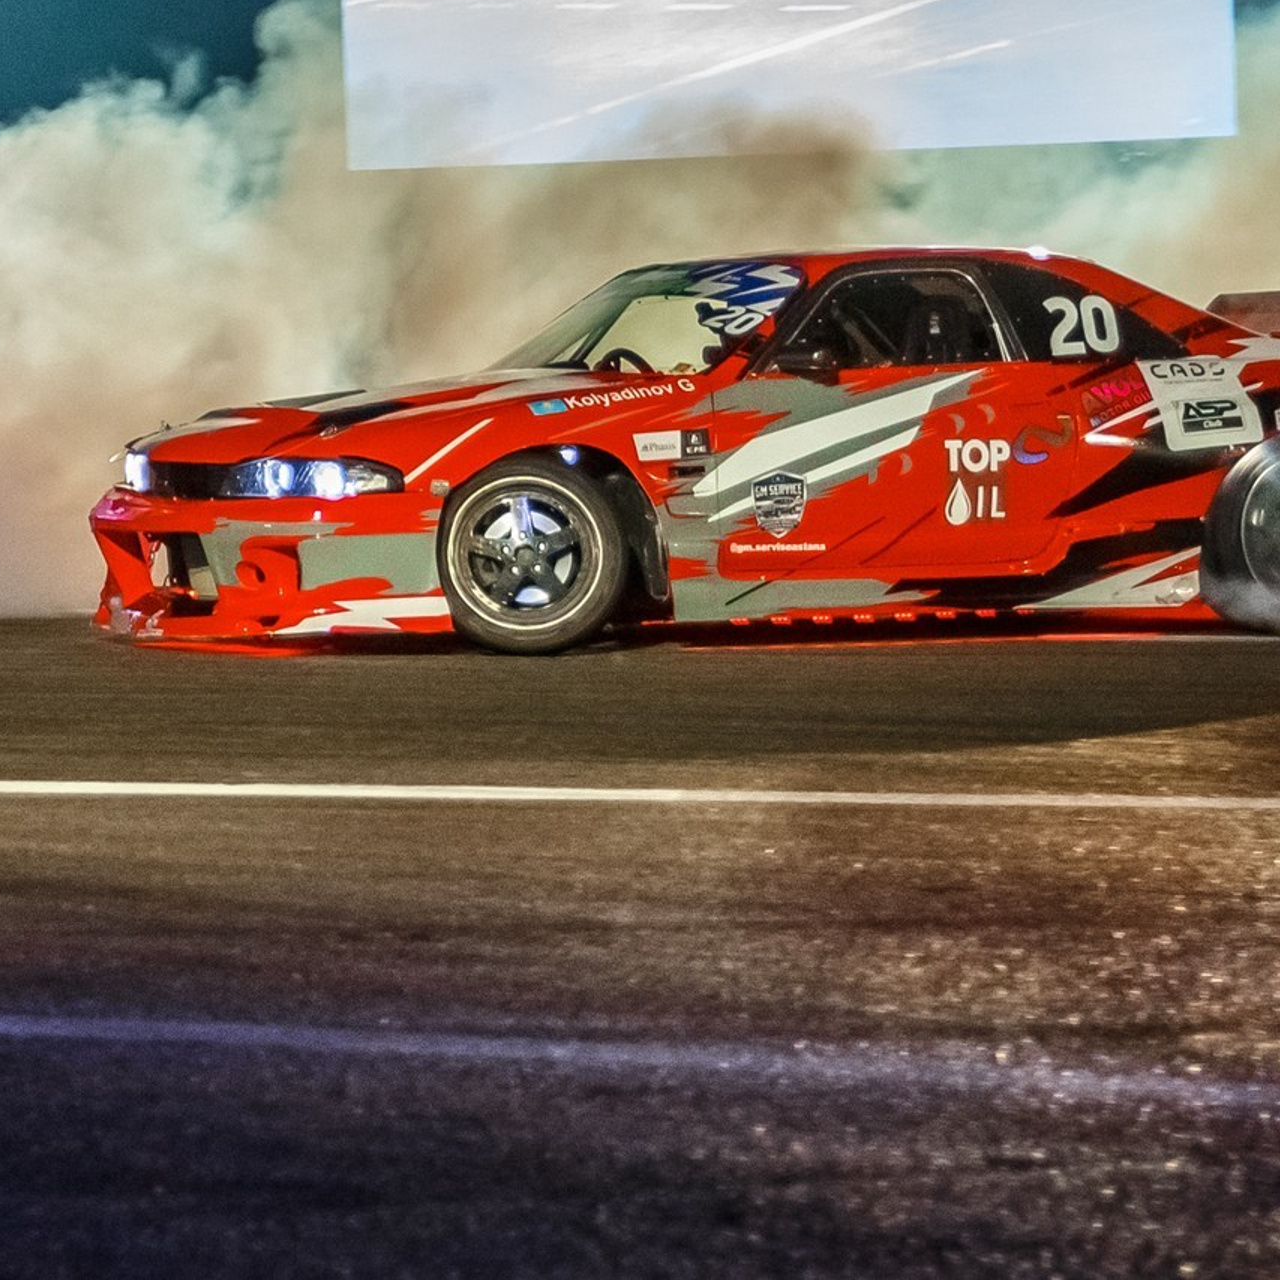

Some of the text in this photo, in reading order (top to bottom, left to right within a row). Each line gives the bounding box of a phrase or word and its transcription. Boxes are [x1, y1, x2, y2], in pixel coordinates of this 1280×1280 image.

[702, 305, 765, 335] 20
[1042, 295, 1119, 355] 20
[564, 378, 695, 409] Kolyadinov G
[1183, 400, 1238, 420] ASP
[944, 439, 1010, 472] TOP
